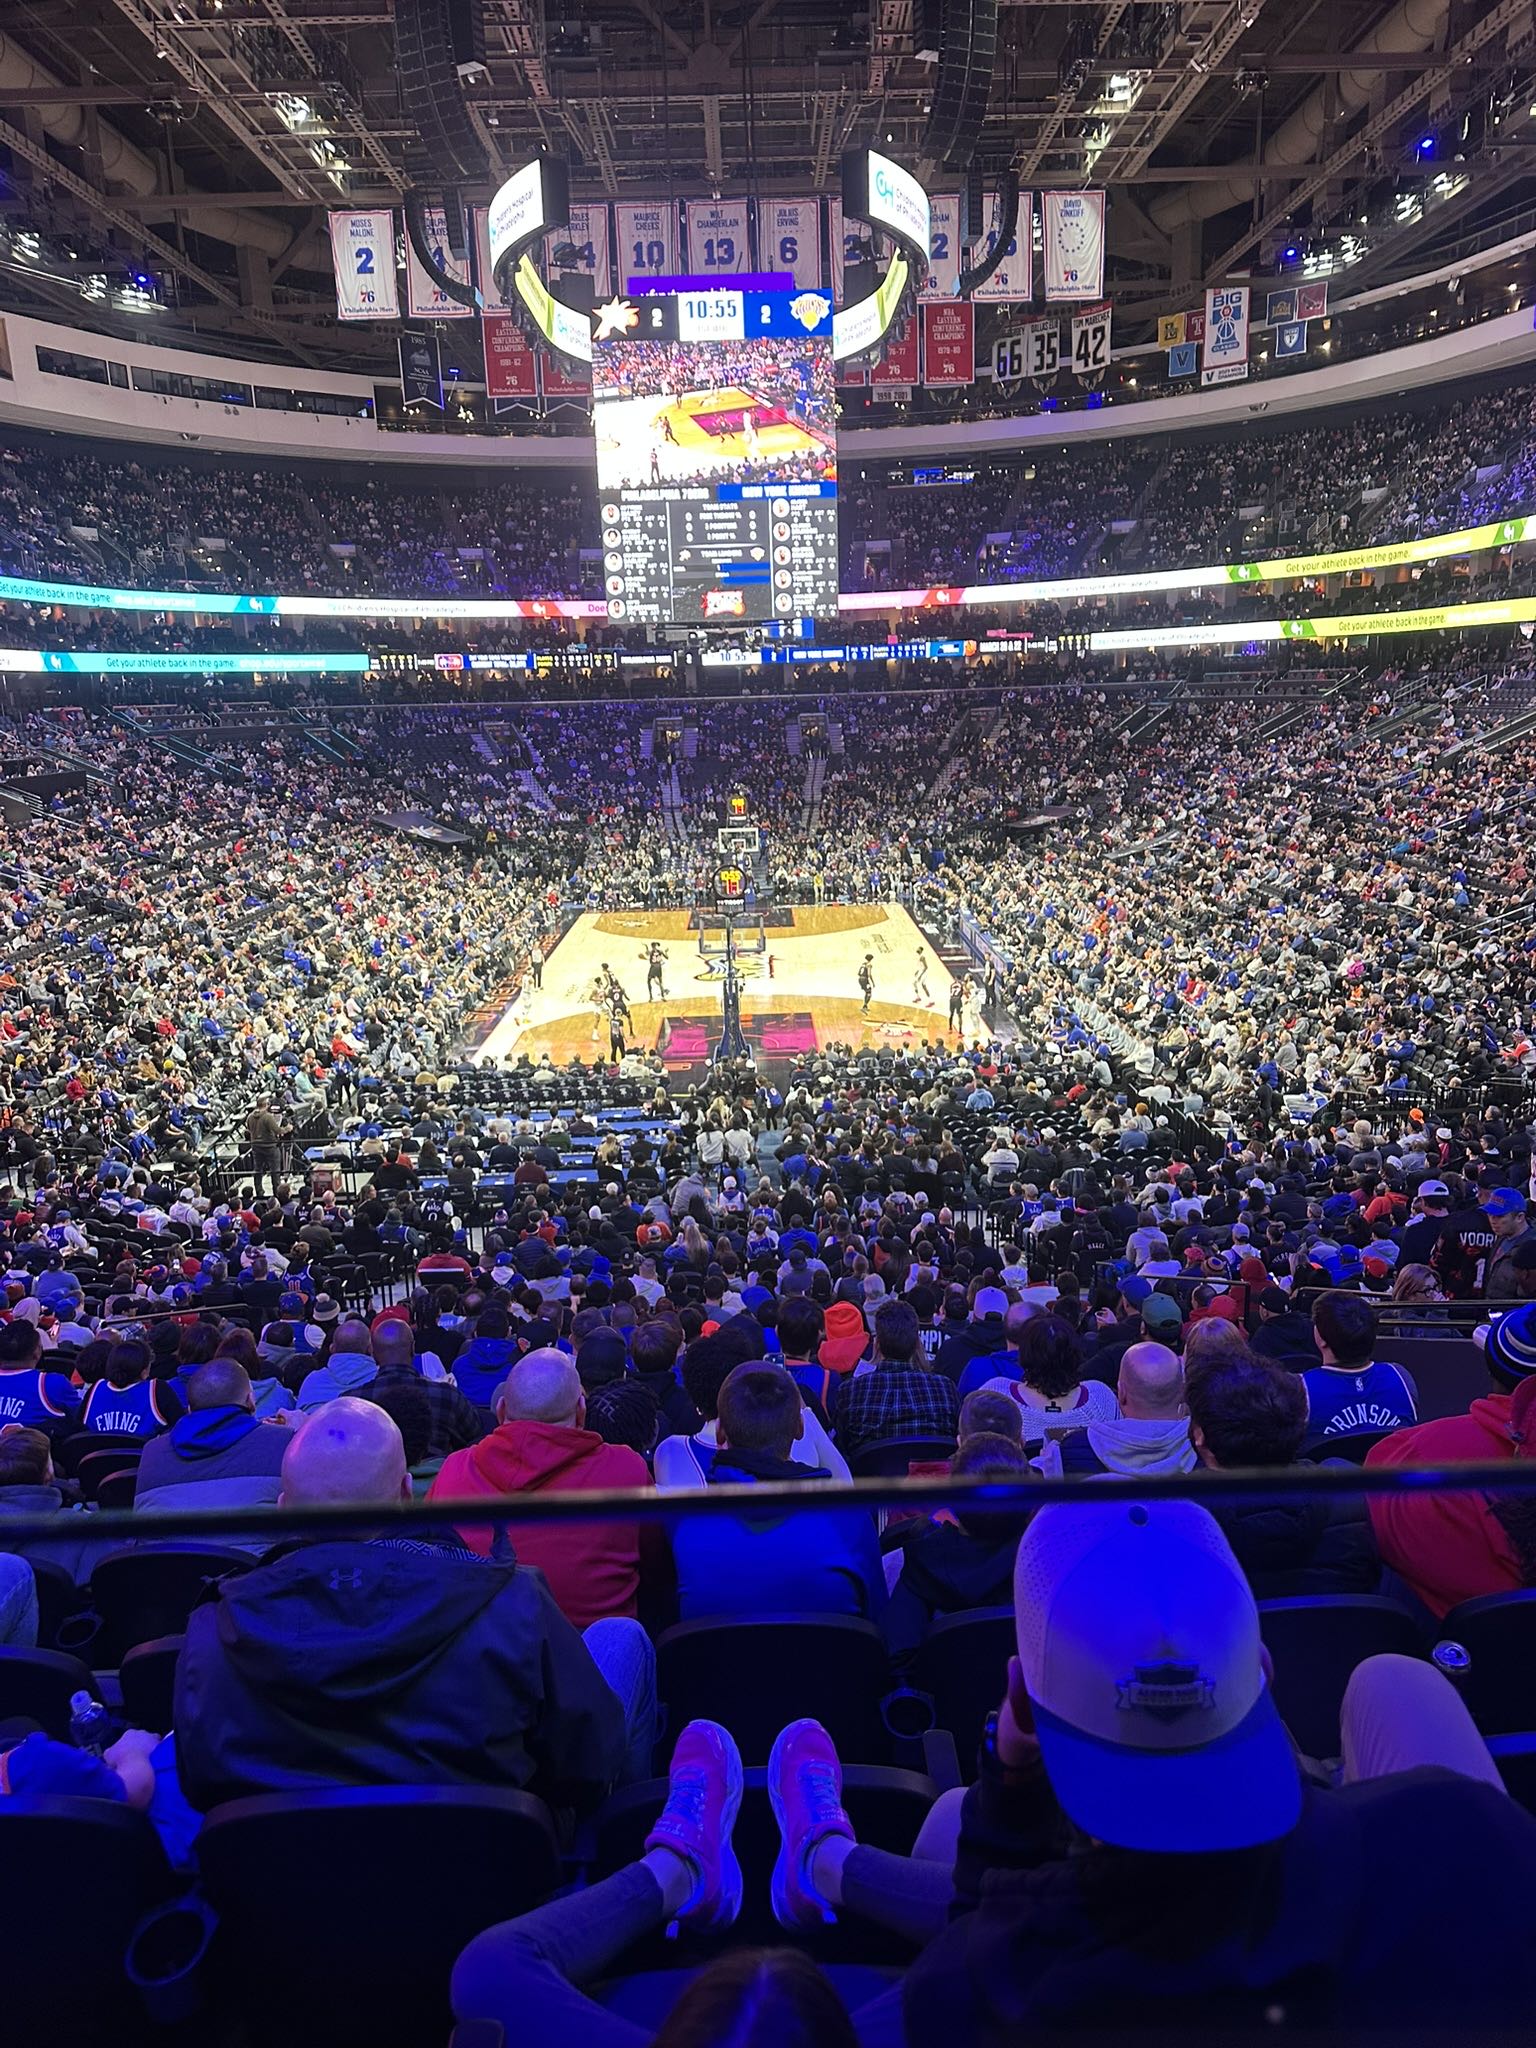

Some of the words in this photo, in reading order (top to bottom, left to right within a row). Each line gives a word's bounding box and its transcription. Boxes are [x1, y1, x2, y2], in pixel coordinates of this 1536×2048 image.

[1063, 199, 1082, 208] DAVID
[633, 212, 660, 222] MAURICE
[709, 209, 724, 219] WILT
[776, 207, 799, 218] JULIUS
[1060, 208, 1084, 217] ZINKOFF
[350, 219, 372, 228] MOSES
[635, 222, 660, 231] CHEEKS
[696, 218, 739, 229] CHAMBERLAIN
[776, 217, 799, 227] ERVING
[349, 228, 375, 238] MALONE
[633, 240, 665, 268] 10
[703, 238, 735, 266] 13
[779, 236, 799, 264] 6
[355, 247, 375, 275] 2
[994, 273, 1008, 286] 76
[1064, 270, 1078, 281] 76
[360, 290, 375, 303] 76
[1213, 291, 1242, 307] BIG
[685, 300, 736, 318] 10:55
[760, 304, 771, 324] 2
[651, 308, 663, 327] 2
[936, 316, 962, 324] EASTERN
[932, 324, 966, 332] CONFERENCE
[491, 336, 526, 345] CONFERENCE
[933, 332, 965, 340] CHAMPIONS
[493, 344, 526, 352] CHAMPIONS
[1034, 331, 1058, 372] 35
[1076, 325, 1106, 368] 42
[1213, 341, 1239, 351] CLASSIC
[997, 339, 1022, 378] 66
[1286, 562, 1300, 573] Get
[1301, 561, 1320, 573] your
[1321, 557, 1348, 569] athlete
[1348, 555, 1365, 567] back
[1374, 552, 1388, 562] the
[46, 588, 65, 599] back
[76, 590, 89, 600] the
[1338, 621, 1351, 631] Get
[1352, 622, 1367, 631] your
[1368, 617, 1394, 630] athlete
[1395, 616, 1411, 627] back
[1418, 615, 1428, 624] the
[106, 657, 119, 667] Get
[120, 660, 136, 669] your
[137, 658, 167, 668] athlete
[168, 658, 188, 668] back
[198, 658, 212, 668] the
[95, 1411, 141, 1433] EWING
